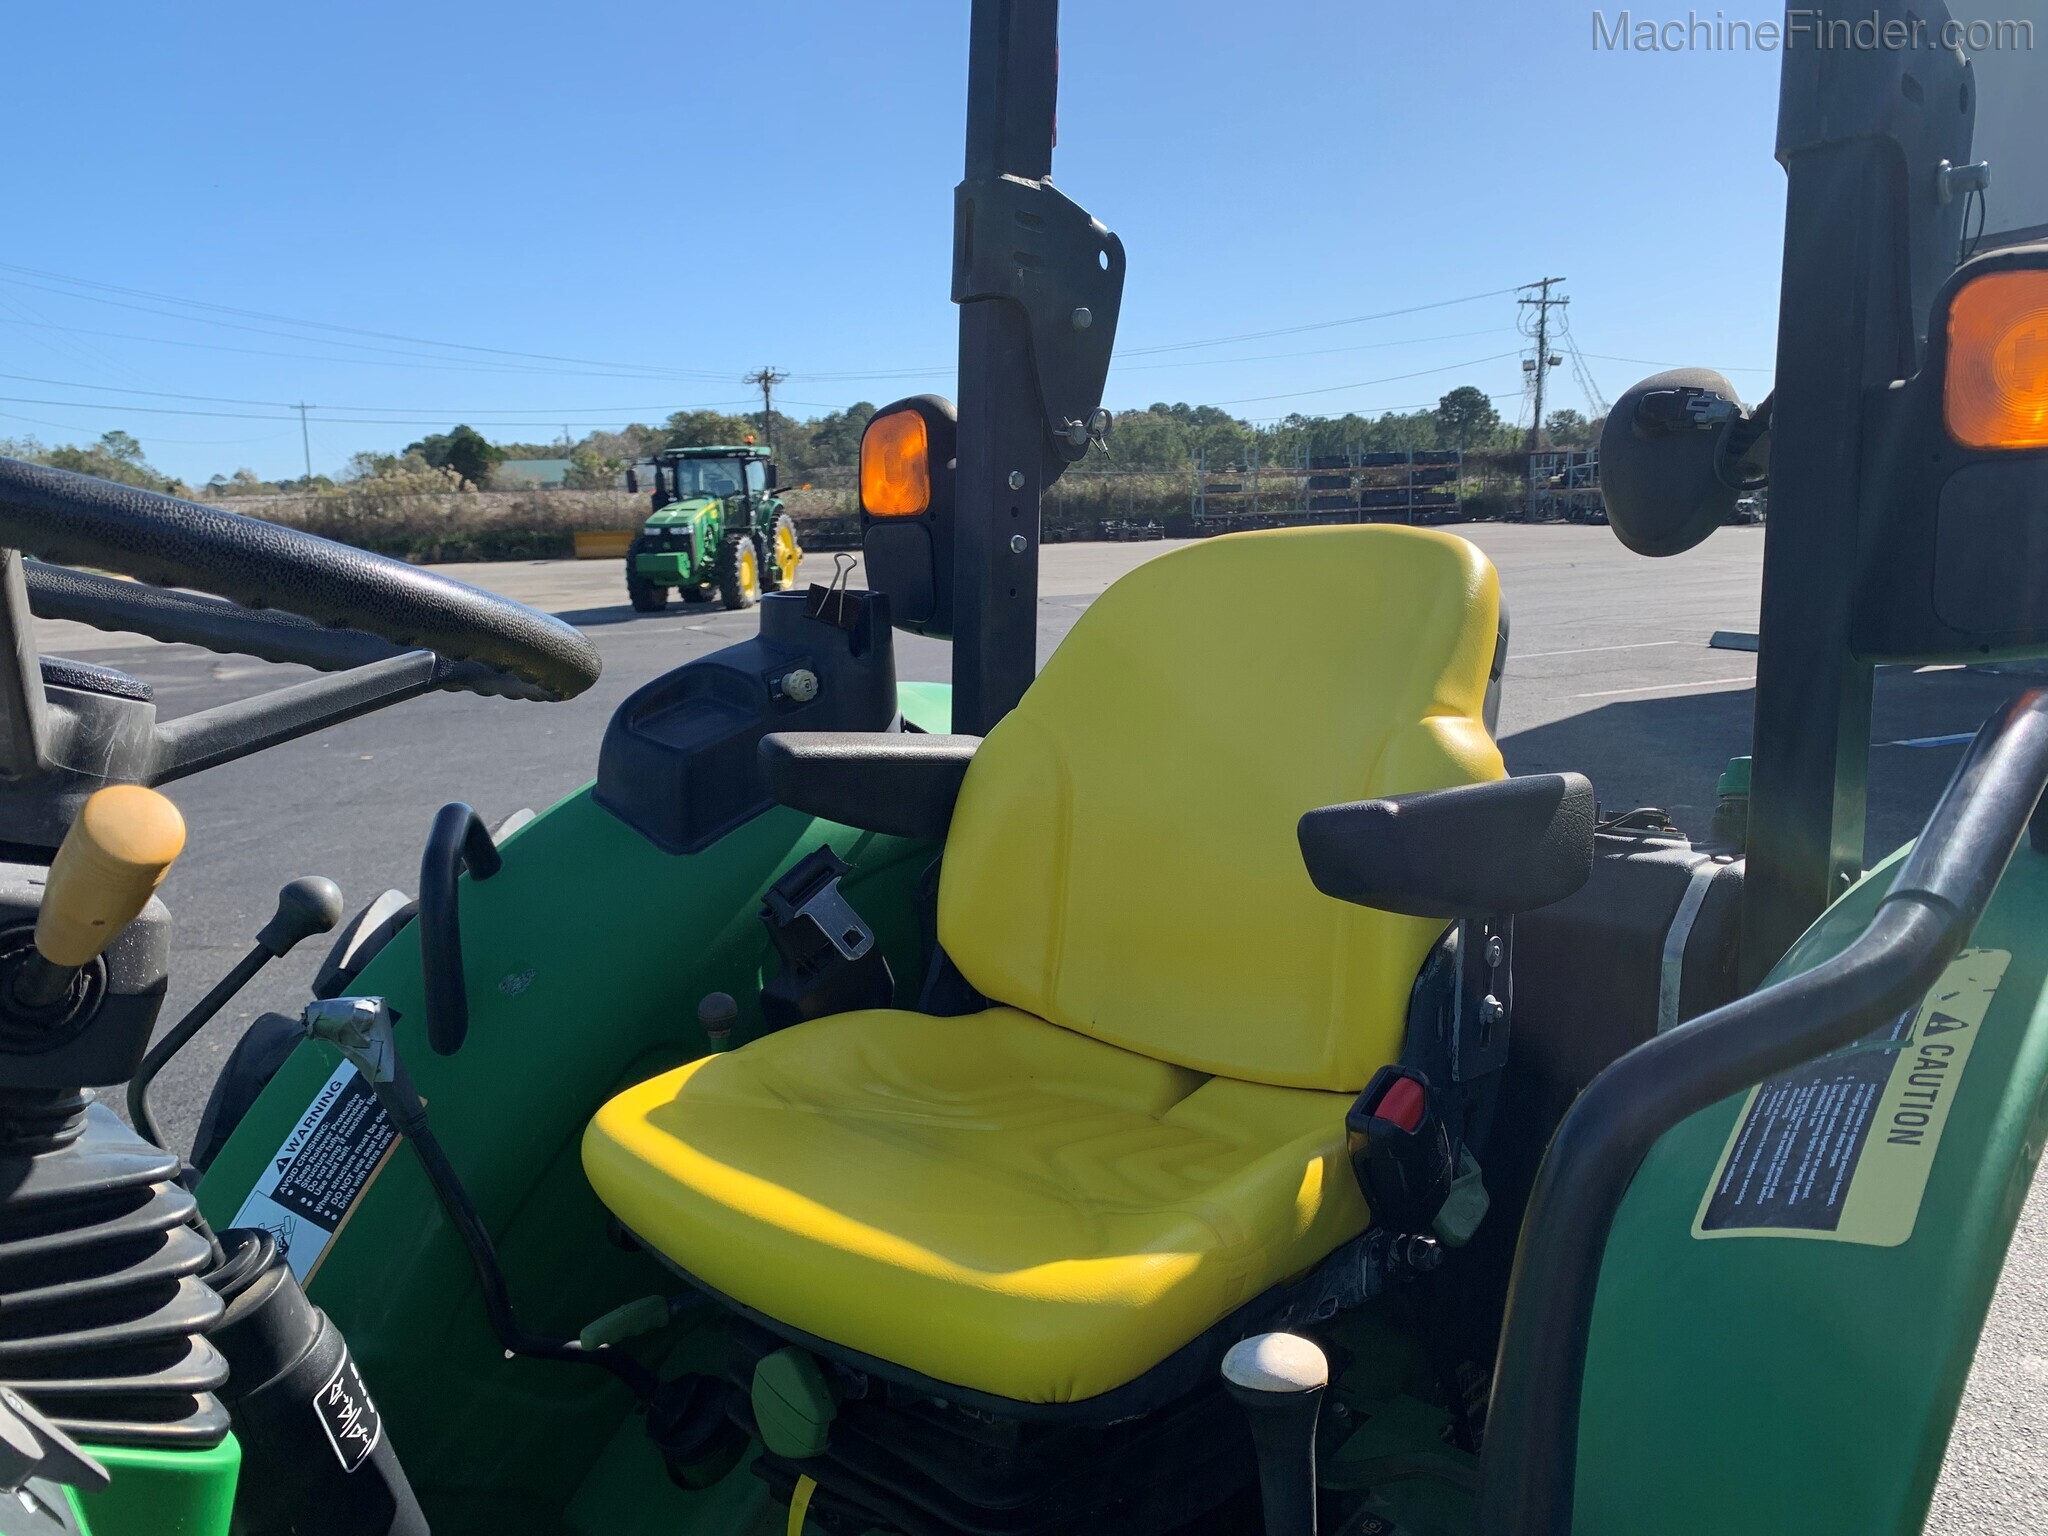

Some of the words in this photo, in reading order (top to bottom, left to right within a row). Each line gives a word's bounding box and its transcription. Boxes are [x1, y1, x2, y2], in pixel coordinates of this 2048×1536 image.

[285, 1081, 342, 1152] WARNING
[1887, 1043, 1955, 1146] CAUTION
[280, 1168, 298, 1193] AVOID
[296, 1121, 330, 1166] CRUSHING:
[294, 1165, 313, 1185] Keep
[308, 1131, 333, 1164] Rollover
[331, 1094, 360, 1130] Protective
[300, 1152, 328, 1188] Structure
[325, 1134, 342, 1152] fully
[338, 1096, 365, 1133] extended.
[307, 1180, 318, 1192] Do
[317, 1166, 328, 1179] not
[325, 1146, 344, 1167] jump
[345, 1105, 369, 1137] machine
[314, 1191, 333, 1212] When
[331, 1155, 356, 1189] structure
[355, 1135, 369, 1154] must
[366, 1124, 377, 1136] be
[314, 1180, 327, 1195] Use
[326, 1162, 339, 1179] seat
[336, 1143, 351, 1161] belt.
[330, 1192, 342, 1205] DO
[340, 1172, 354, 1191] NOT
[353, 1158, 365, 1172] use
[364, 1140, 377, 1157] seat
[374, 1122, 389, 1140] belt.
[338, 1188, 355, 1208] Drive
[354, 1171, 367, 1186] with
[365, 1150, 380, 1169] extra
[379, 1130, 394, 1149] care.
